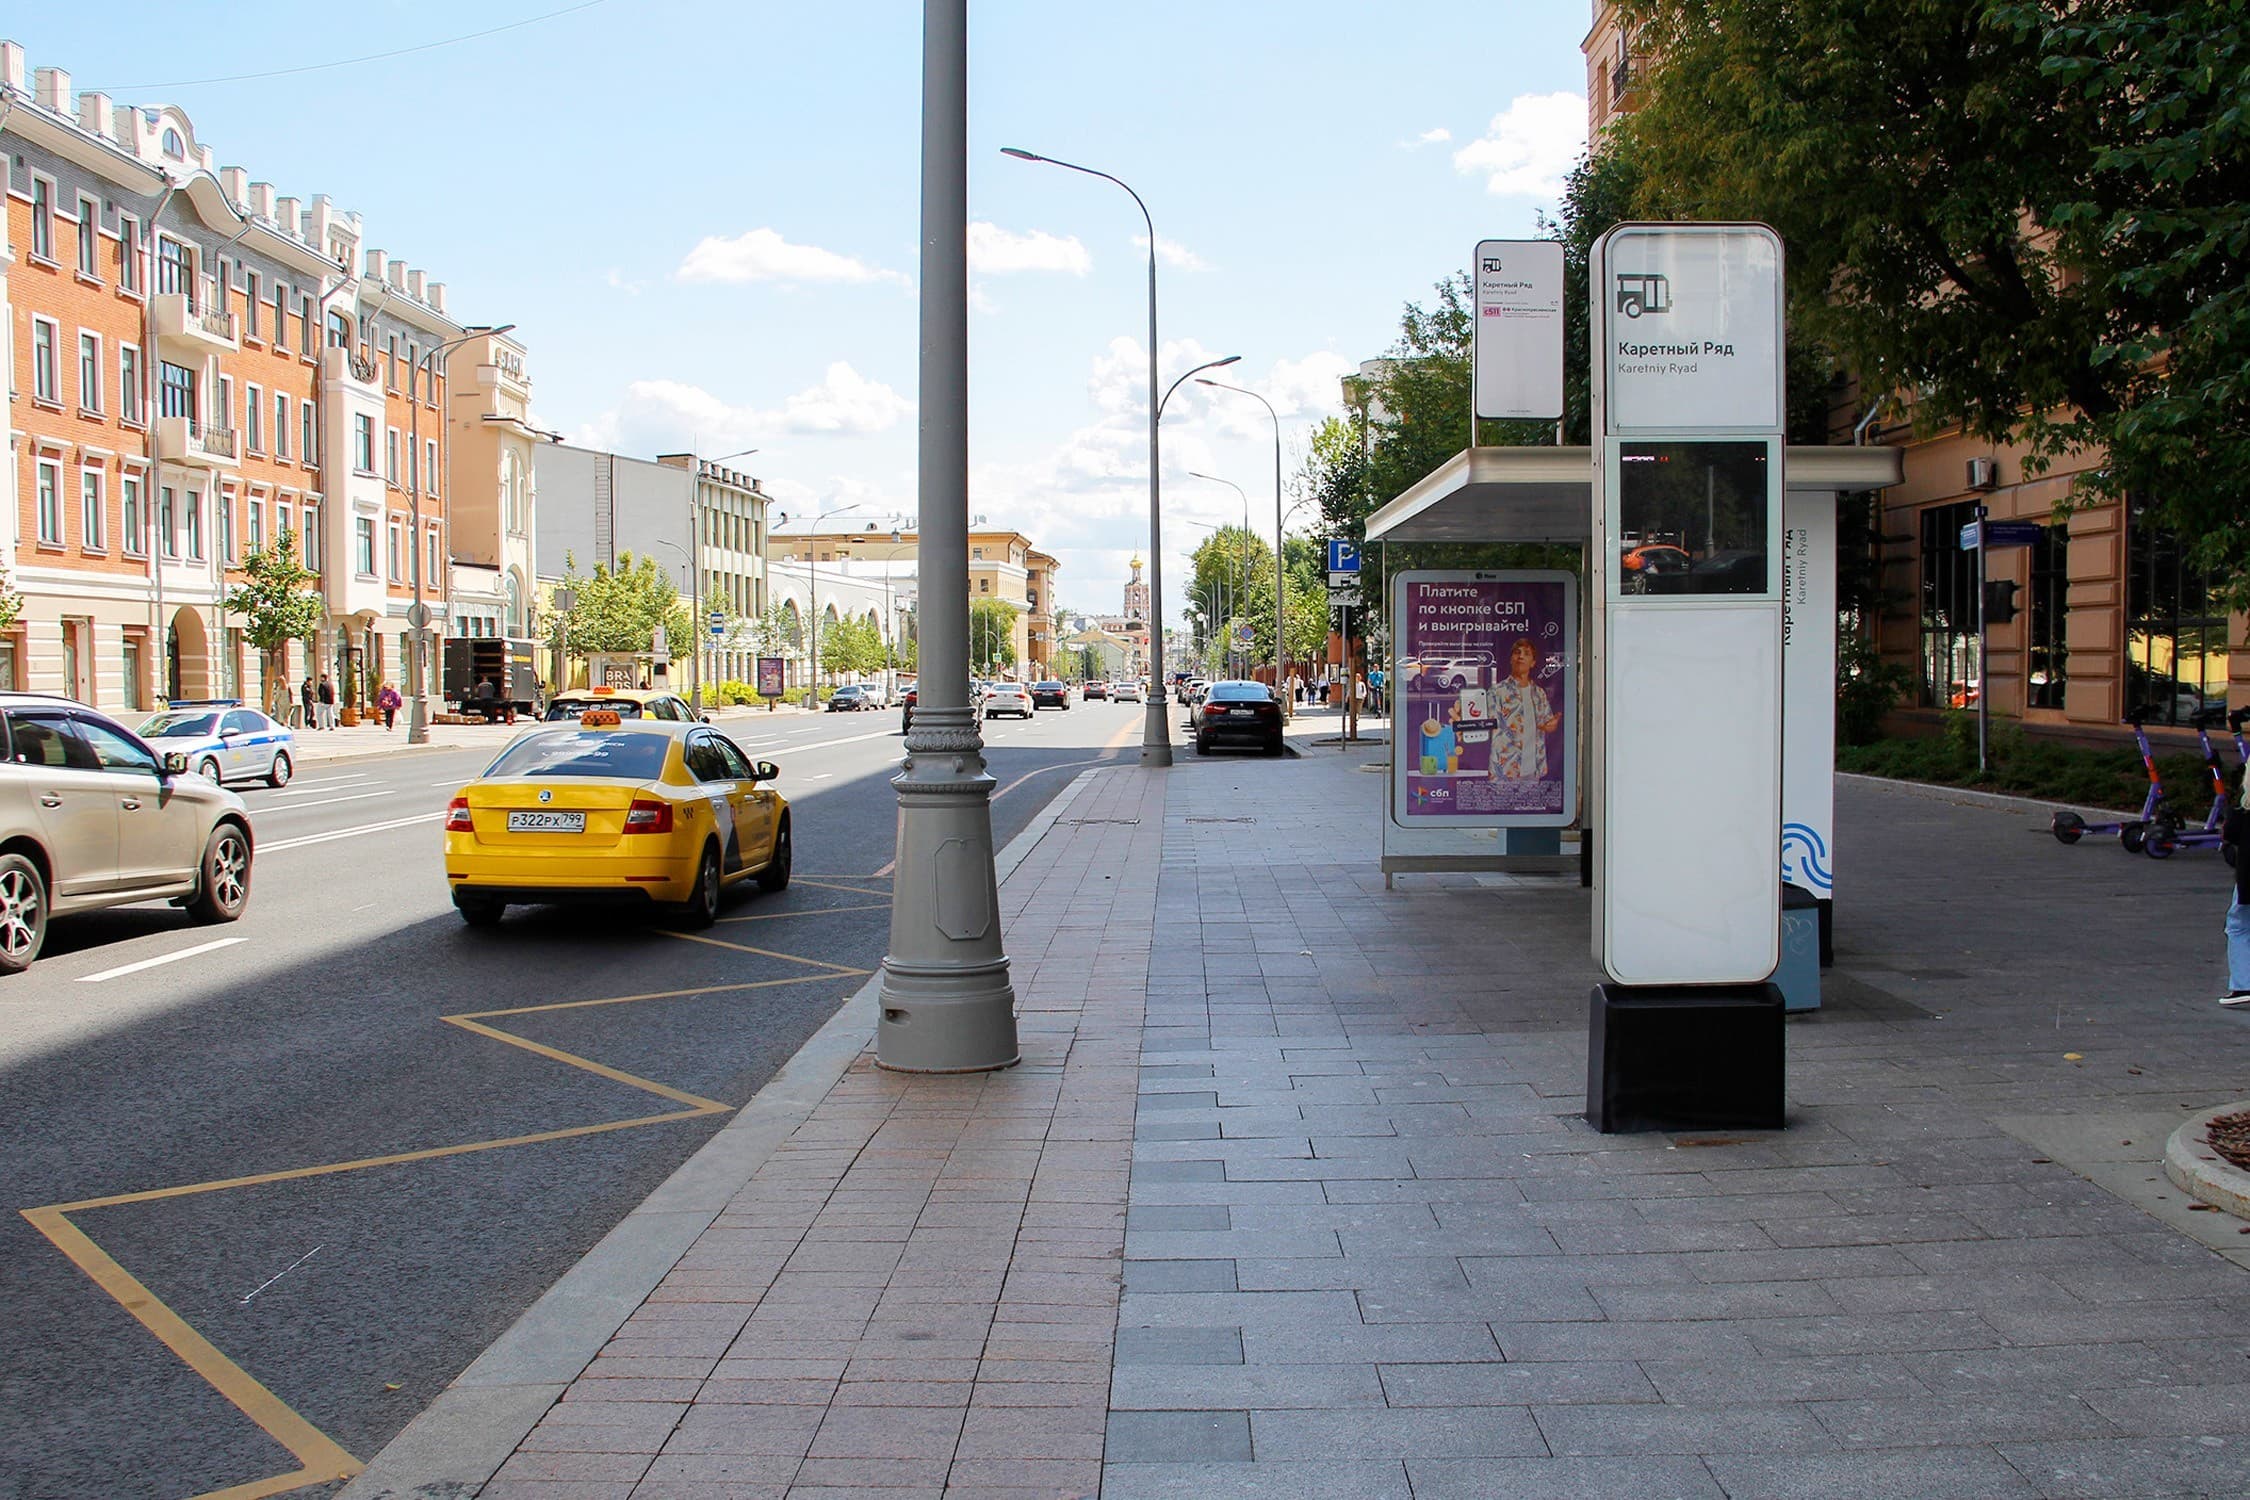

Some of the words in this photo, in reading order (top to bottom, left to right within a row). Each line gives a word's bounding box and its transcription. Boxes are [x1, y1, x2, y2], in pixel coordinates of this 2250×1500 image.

[1618, 342, 1699, 357] Каретный
[1703, 341, 1735, 357] Ряд
[1618, 362, 1666, 375] Karetniy
[1669, 362, 1698, 375] Ryad
[1796, 529, 1808, 556] Ryad
[1337, 543, 1354, 568] P
[1797, 560, 1808, 604] Karetniy
[1419, 585, 1478, 598] Платите
[1418, 604, 1437, 615] по
[1440, 604, 1491, 615] кнопке
[1494, 602, 1525, 615] СБП
[1418, 622, 1428, 632] и
[1431, 619, 1529, 634] выигрывайте!
[606, 671, 632, 681] BRA
[1430, 788, 1449, 798] сбп
[562, 813, 582, 823] 799
